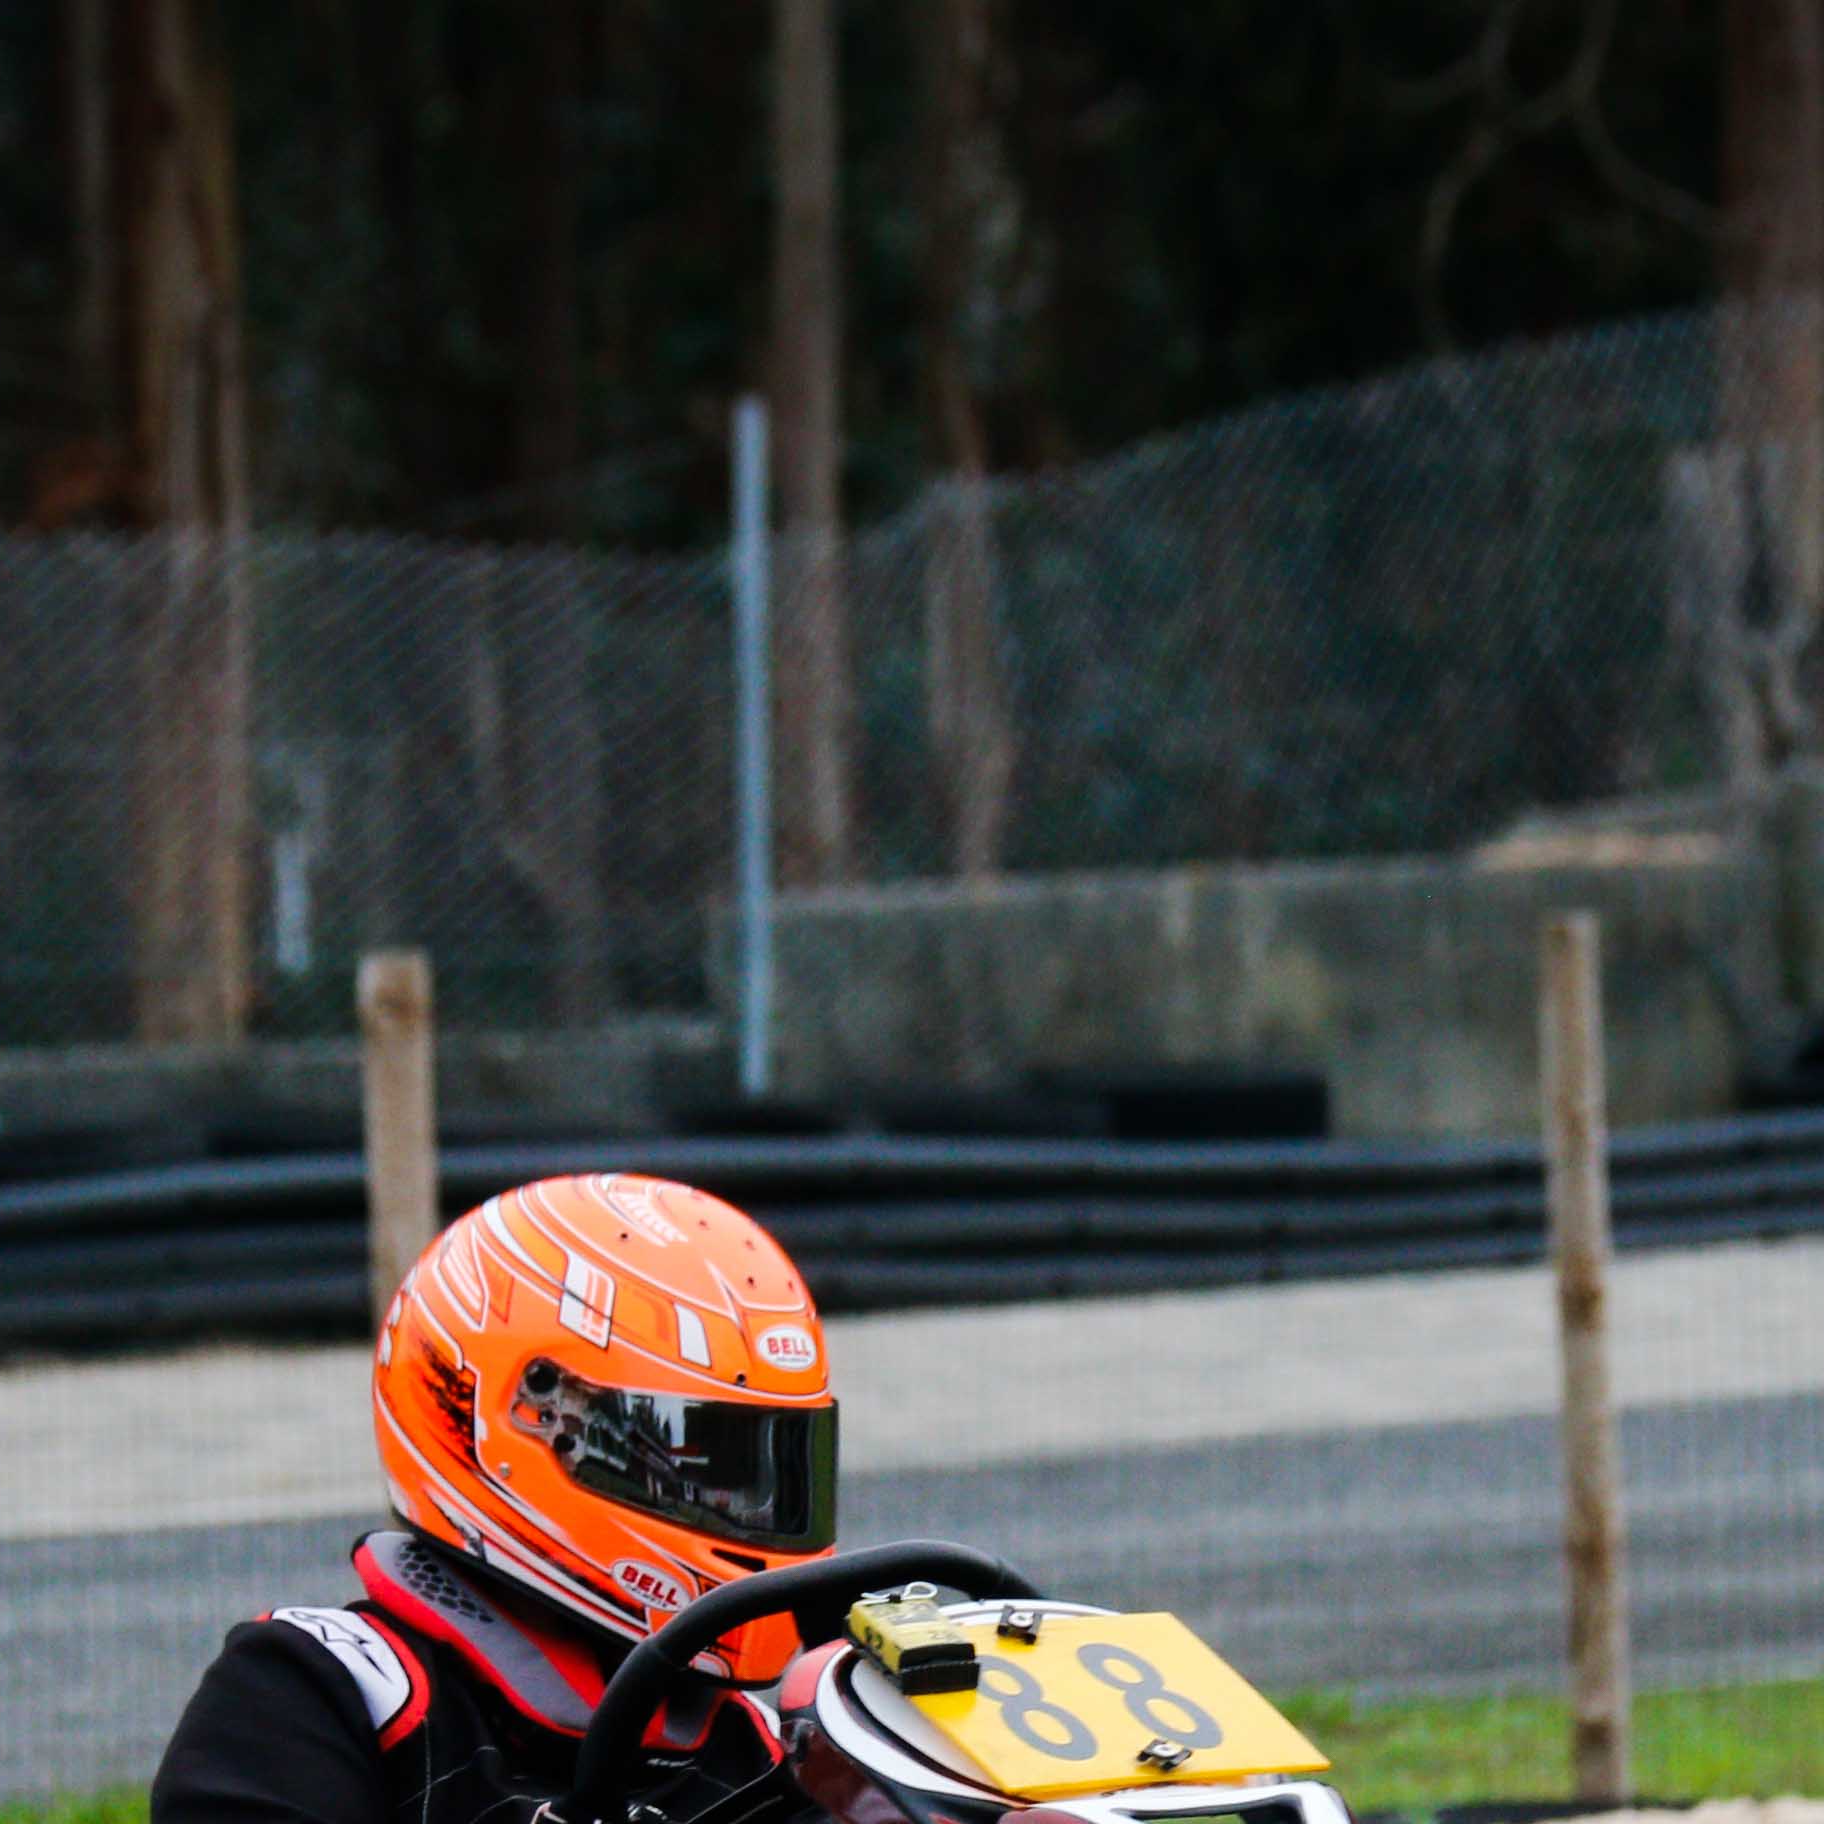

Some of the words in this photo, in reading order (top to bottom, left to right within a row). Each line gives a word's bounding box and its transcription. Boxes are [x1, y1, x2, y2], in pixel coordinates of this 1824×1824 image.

[766, 1336, 812, 1356] BELL
[621, 1564, 679, 1606] BELL
[973, 1642, 1224, 1762] 88
